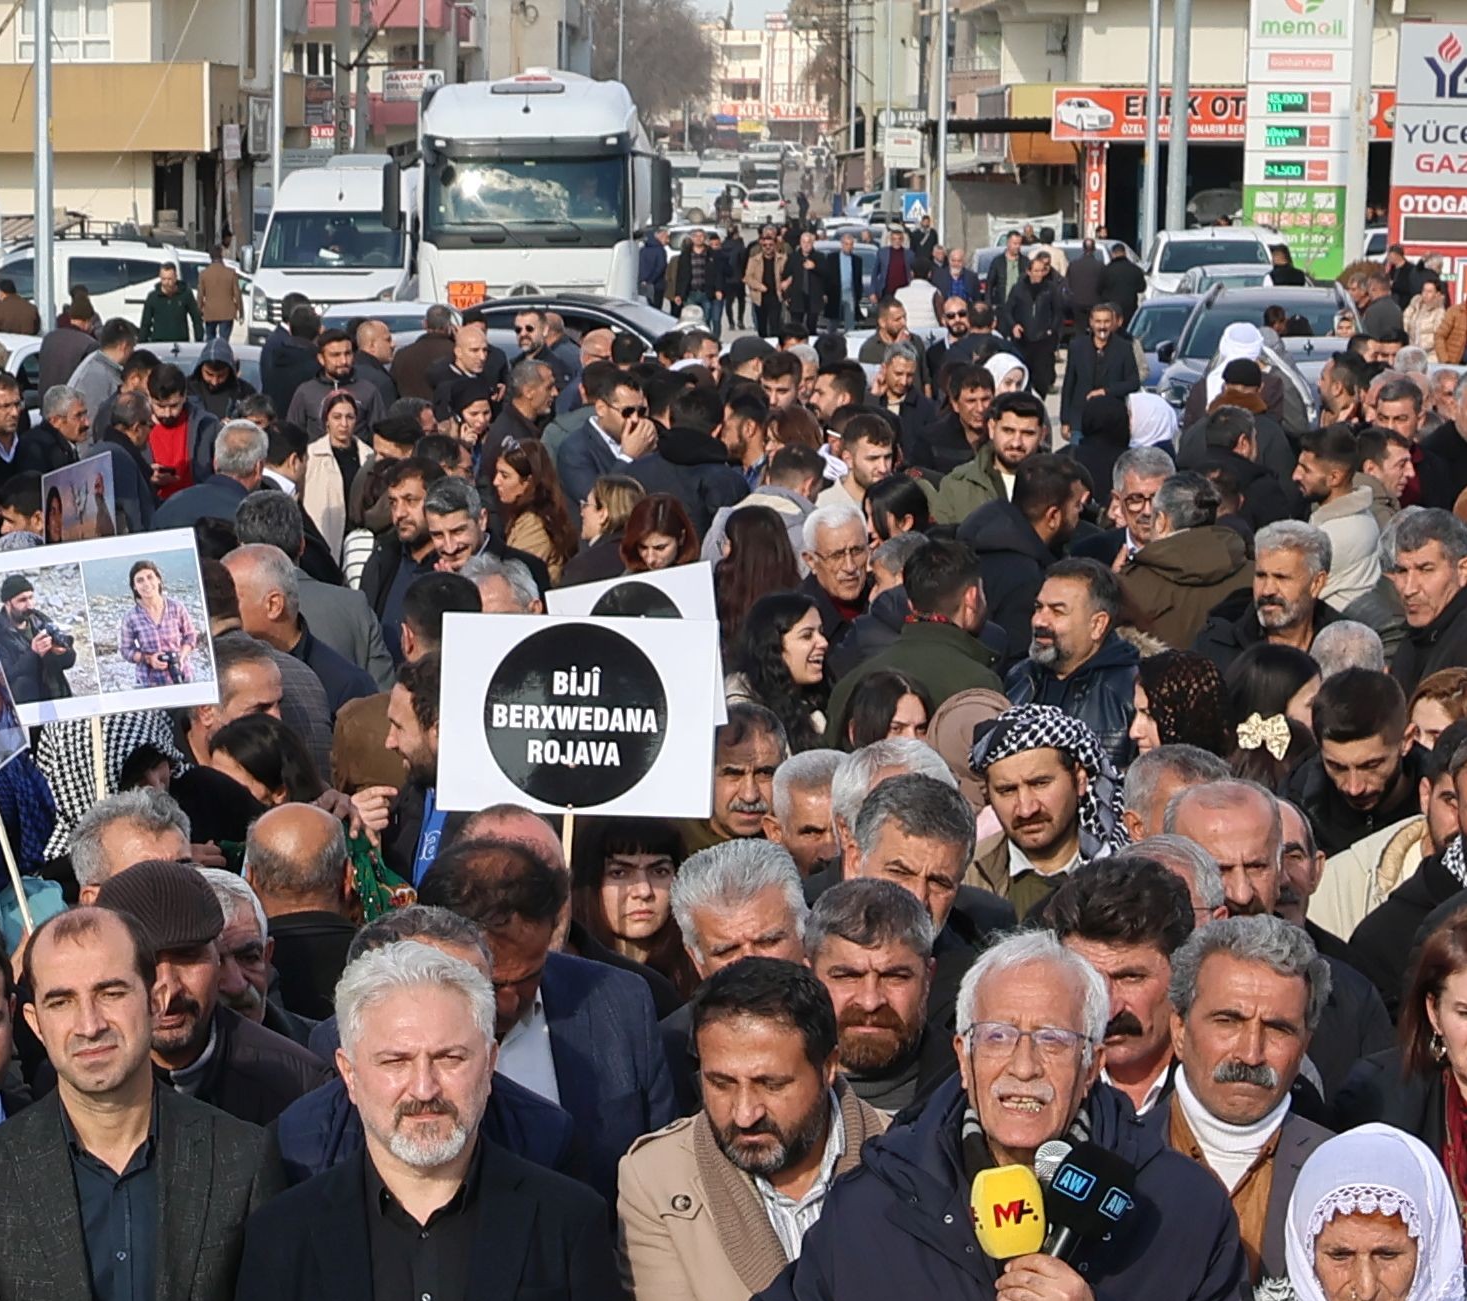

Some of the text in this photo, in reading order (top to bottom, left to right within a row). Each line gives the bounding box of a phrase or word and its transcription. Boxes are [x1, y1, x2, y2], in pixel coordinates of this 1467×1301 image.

[1261, 19, 1343, 36] memoil
[1210, 95, 1246, 117] OT
[492, 703, 659, 734] BERXWEDANA
[526, 738, 621, 767] ROJAVA
[1058, 1169, 1089, 1195] AW
